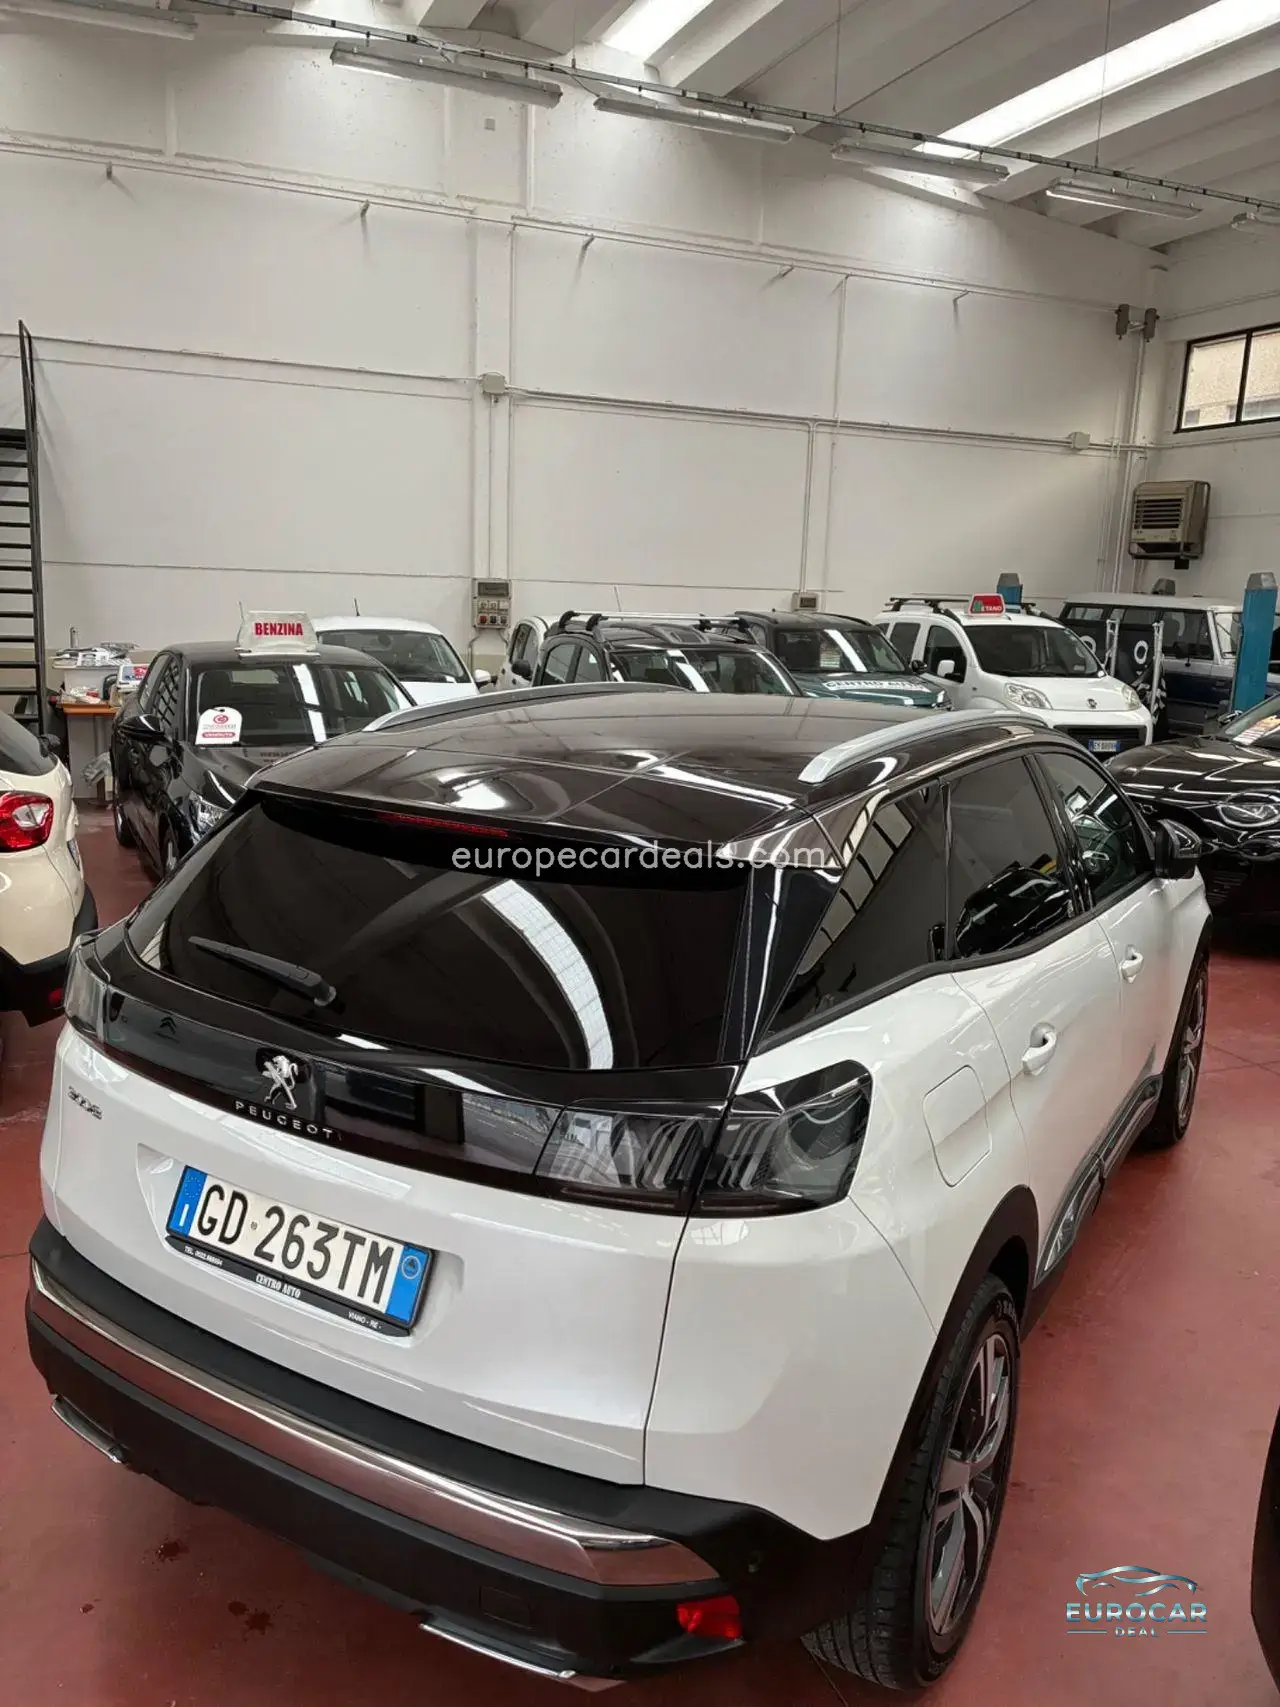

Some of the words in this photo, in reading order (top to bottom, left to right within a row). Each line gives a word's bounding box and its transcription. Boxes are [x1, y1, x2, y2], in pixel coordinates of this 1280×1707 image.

[254, 622, 304, 636] BENZINA
[235, 1100, 333, 1139] PEUGEOT
[197, 1184, 249, 1246] GD
[254, 1205, 395, 1305] 263TM
[255, 1273, 282, 1291] CENTRO
[281, 1285, 301, 1299] AUTO
